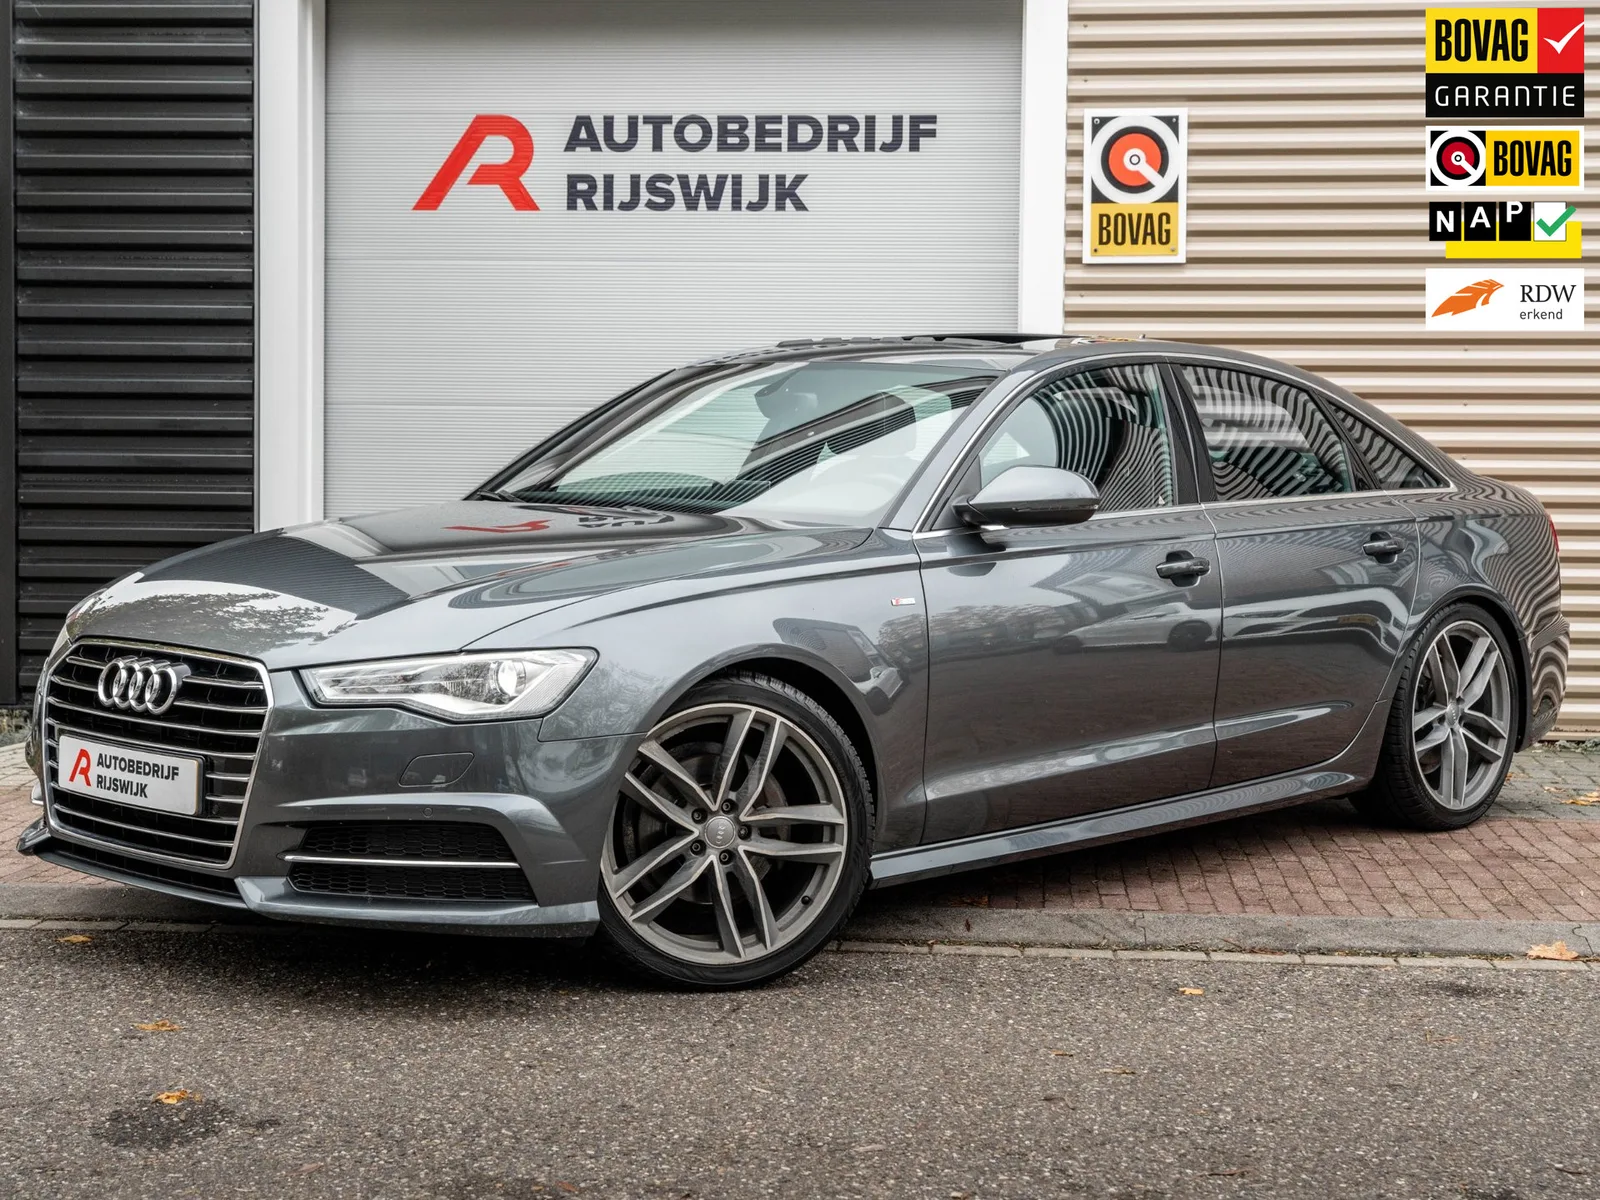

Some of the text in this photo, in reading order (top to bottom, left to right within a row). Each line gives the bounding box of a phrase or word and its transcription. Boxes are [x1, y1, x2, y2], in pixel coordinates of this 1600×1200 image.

[564, 115, 937, 153] AUTOBEDRIJF
[566, 174, 809, 211] RIJSWIJK
[1098, 212, 1171, 246] BOVAG
[96, 753, 179, 781] AUTOBEDRIJF
[96, 774, 148, 798] RIJSWIJK
